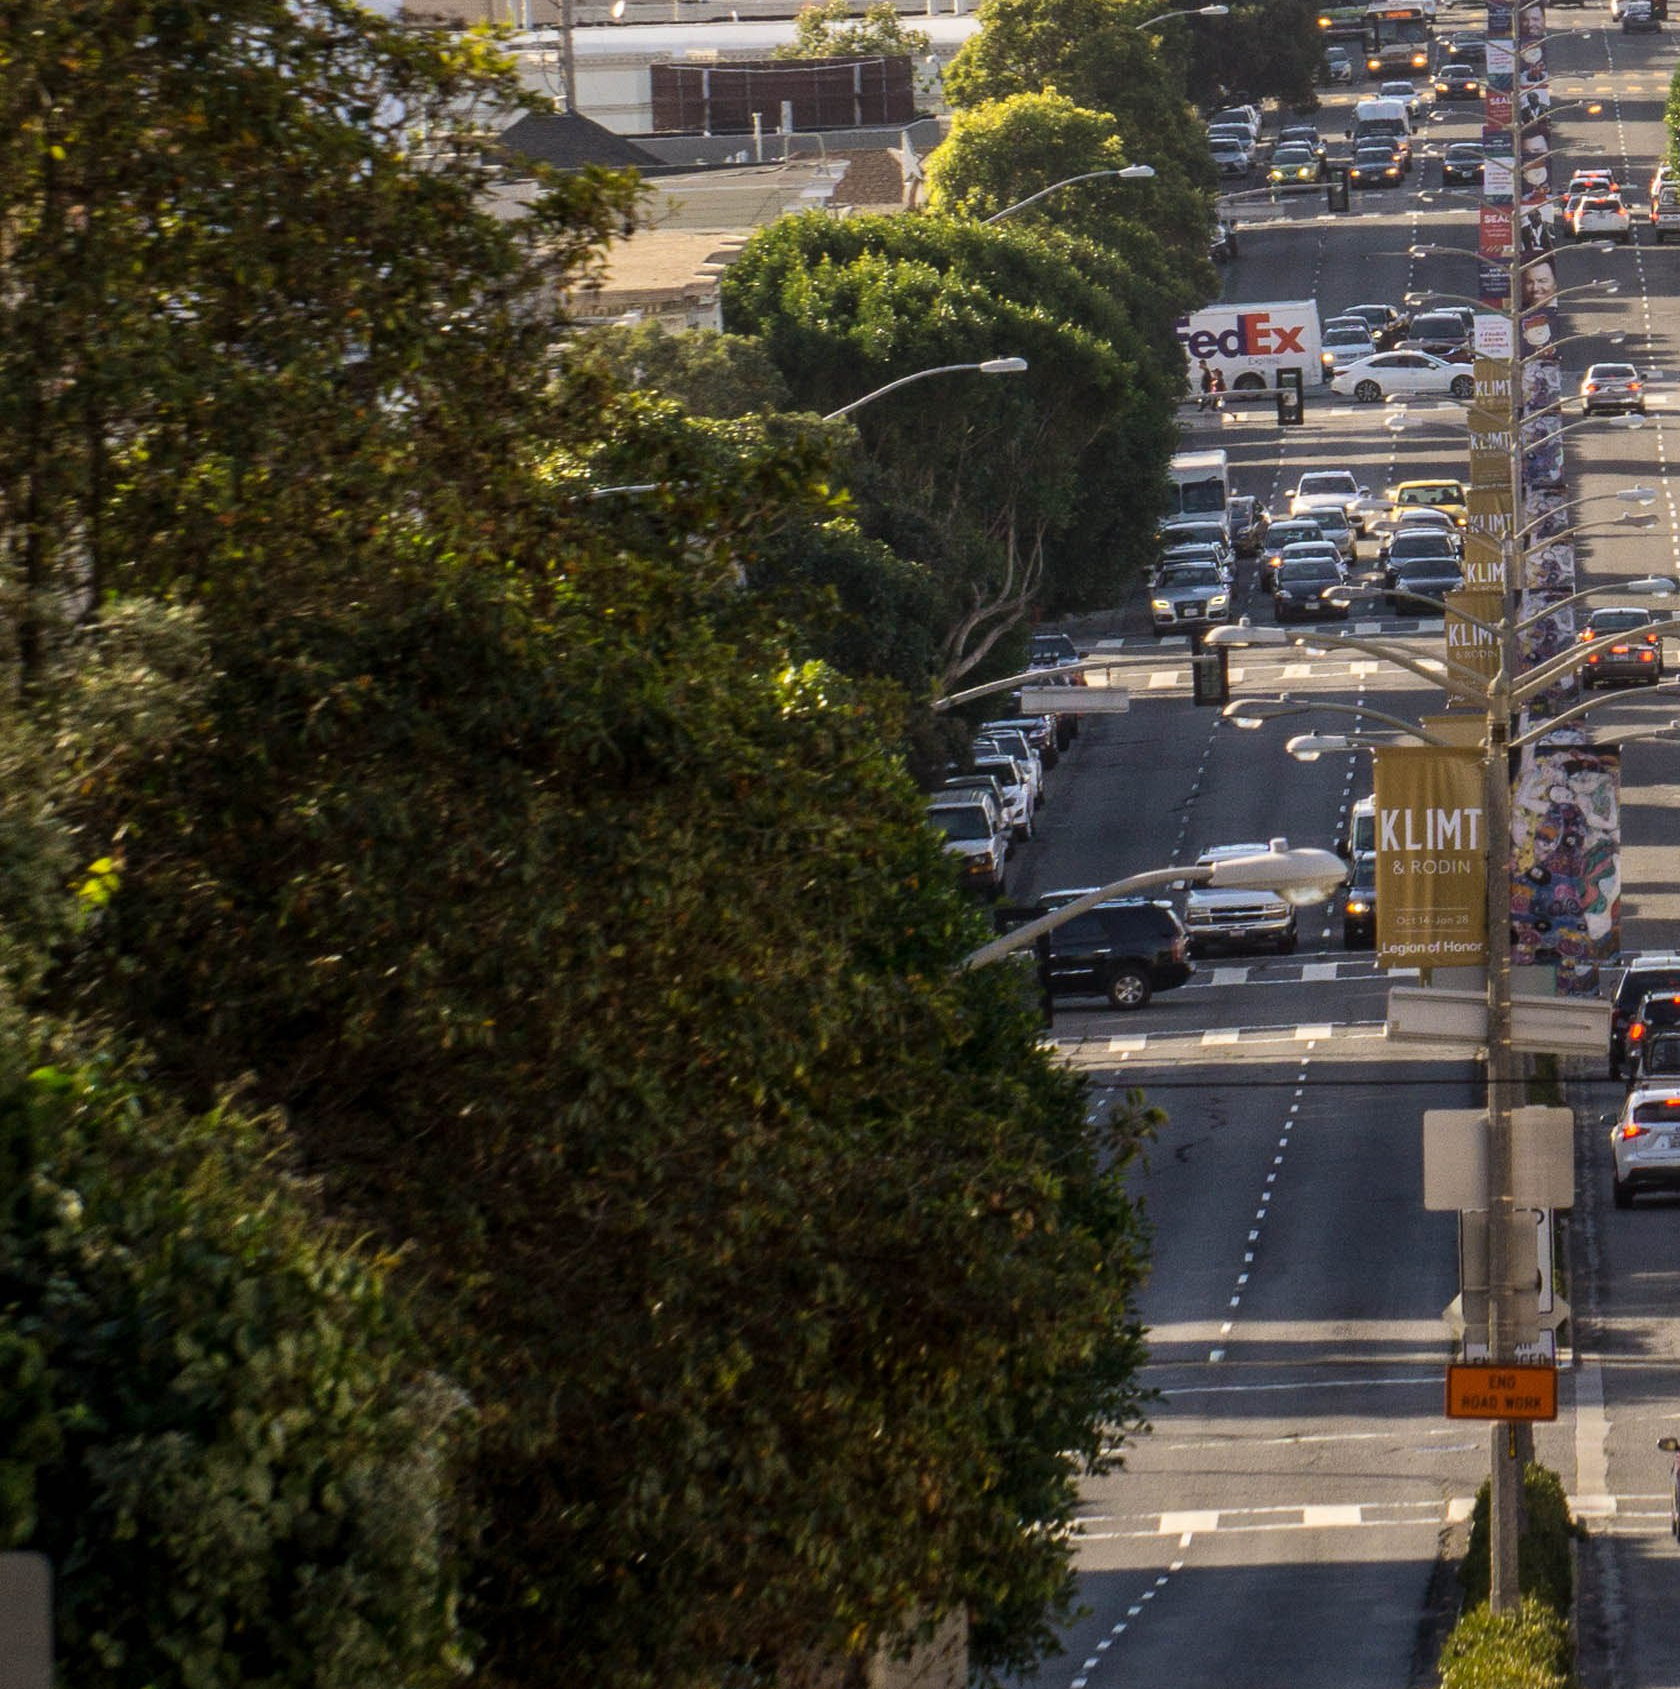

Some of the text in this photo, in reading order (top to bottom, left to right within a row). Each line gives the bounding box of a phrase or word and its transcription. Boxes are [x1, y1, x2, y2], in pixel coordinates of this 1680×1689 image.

[1489, 96, 1512, 105] SEAL
[1484, 214, 1511, 223] SEAL
[1475, 379, 1512, 397] KLIMT
[1470, 431, 1511, 450] KLIMT
[1467, 562, 1505, 584] KLIM
[1380, 808, 1483, 852] KLIMT
[1392, 859, 1471, 875] & RODIN
[1381, 940, 1483, 957] Legion of Honor
[1488, 1374, 1517, 1390] END
[1461, 1394, 1543, 1410] ROAD WORK
